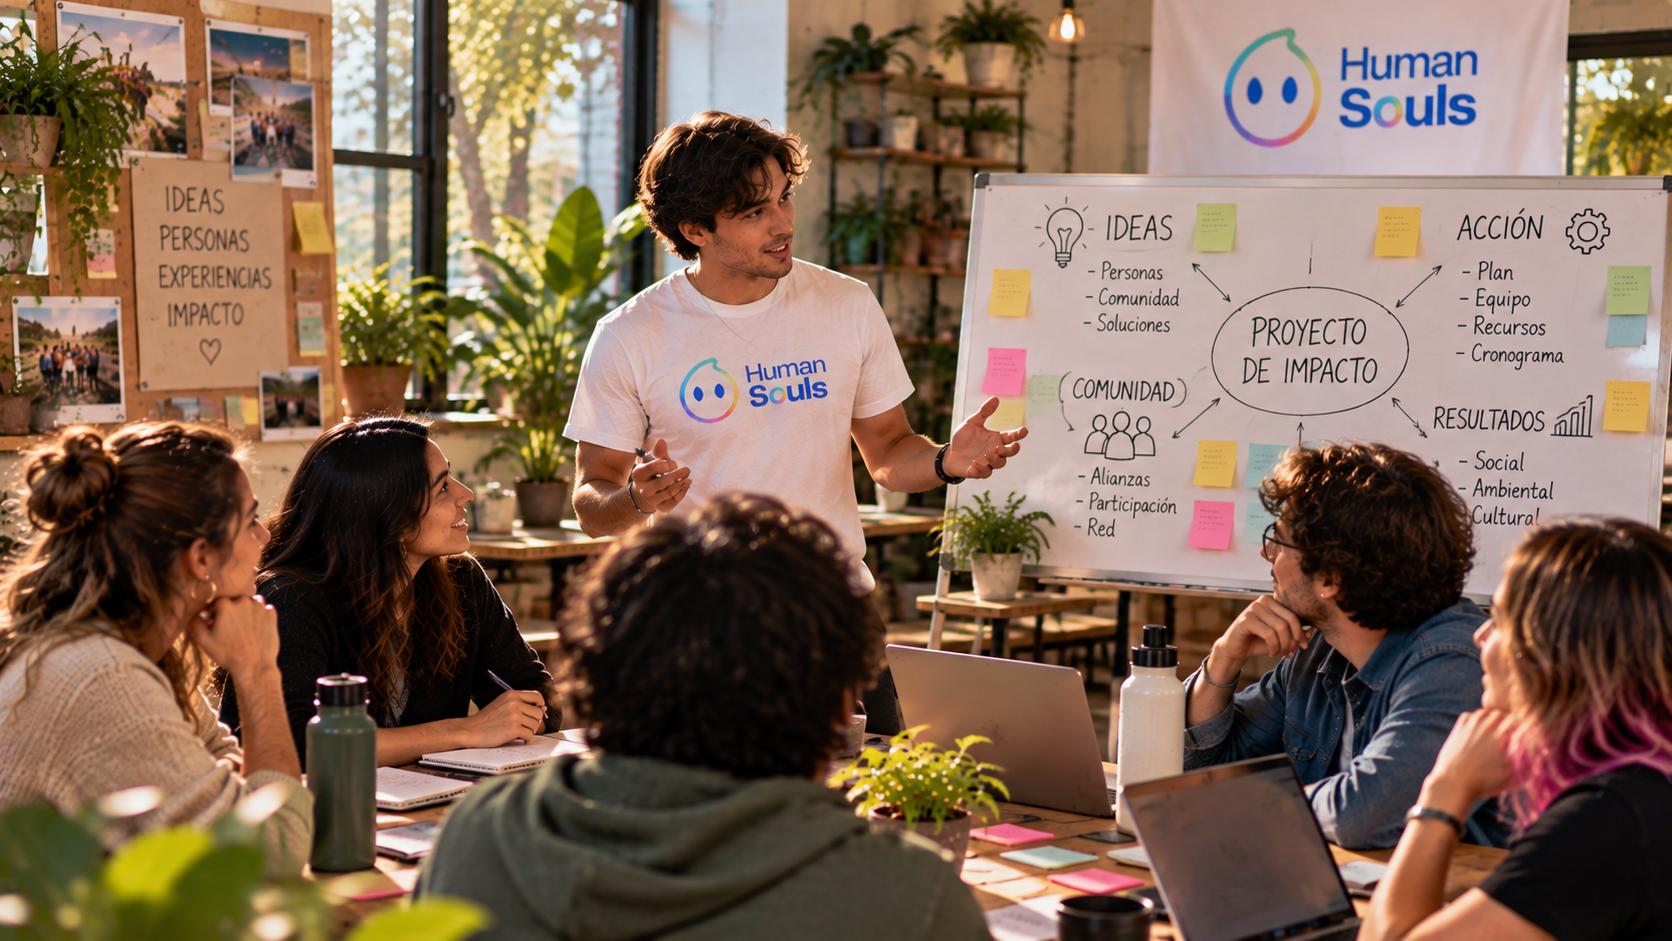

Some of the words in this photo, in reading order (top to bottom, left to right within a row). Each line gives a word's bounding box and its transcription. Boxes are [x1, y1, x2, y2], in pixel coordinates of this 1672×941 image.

[1342, 47, 1477, 80] Human
[1340, 85, 1476, 127] Souls
[166, 186, 224, 214] IDEAS
[1107, 215, 1172, 240] IDEAS
[1457, 208, 1543, 240] ACCIÓN
[160, 225, 249, 252] PERSONAS
[159, 265, 272, 289] EXPERIENCIAS
[1102, 261, 1163, 280] Personas
[1479, 261, 1513, 280] Plan
[1099, 288, 1179, 306] Comunidad
[1476, 288, 1530, 314] Equipo
[168, 302, 243, 327] IMPACTO
[1097, 313, 1170, 332] Soluciones
[1474, 315, 1545, 335] Recursos
[1252, 317, 1366, 347] PROYECTO
[1472, 343, 1564, 370] Cronograma
[745, 358, 827, 382] Human
[1243, 357, 1271, 384] DE
[1285, 357, 1377, 383] IMPACTO
[747, 377, 828, 407] Souls
[1434, 406, 1544, 432] RESULTADOS
[1475, 450, 1524, 471] Social
[1091, 467, 1150, 487] Alianzas
[1473, 478, 1553, 499] Ambiental
[1090, 492, 1176, 519] Participación
[1472, 505, 1541, 527] Cultural
[1088, 518, 1115, 537] Red
